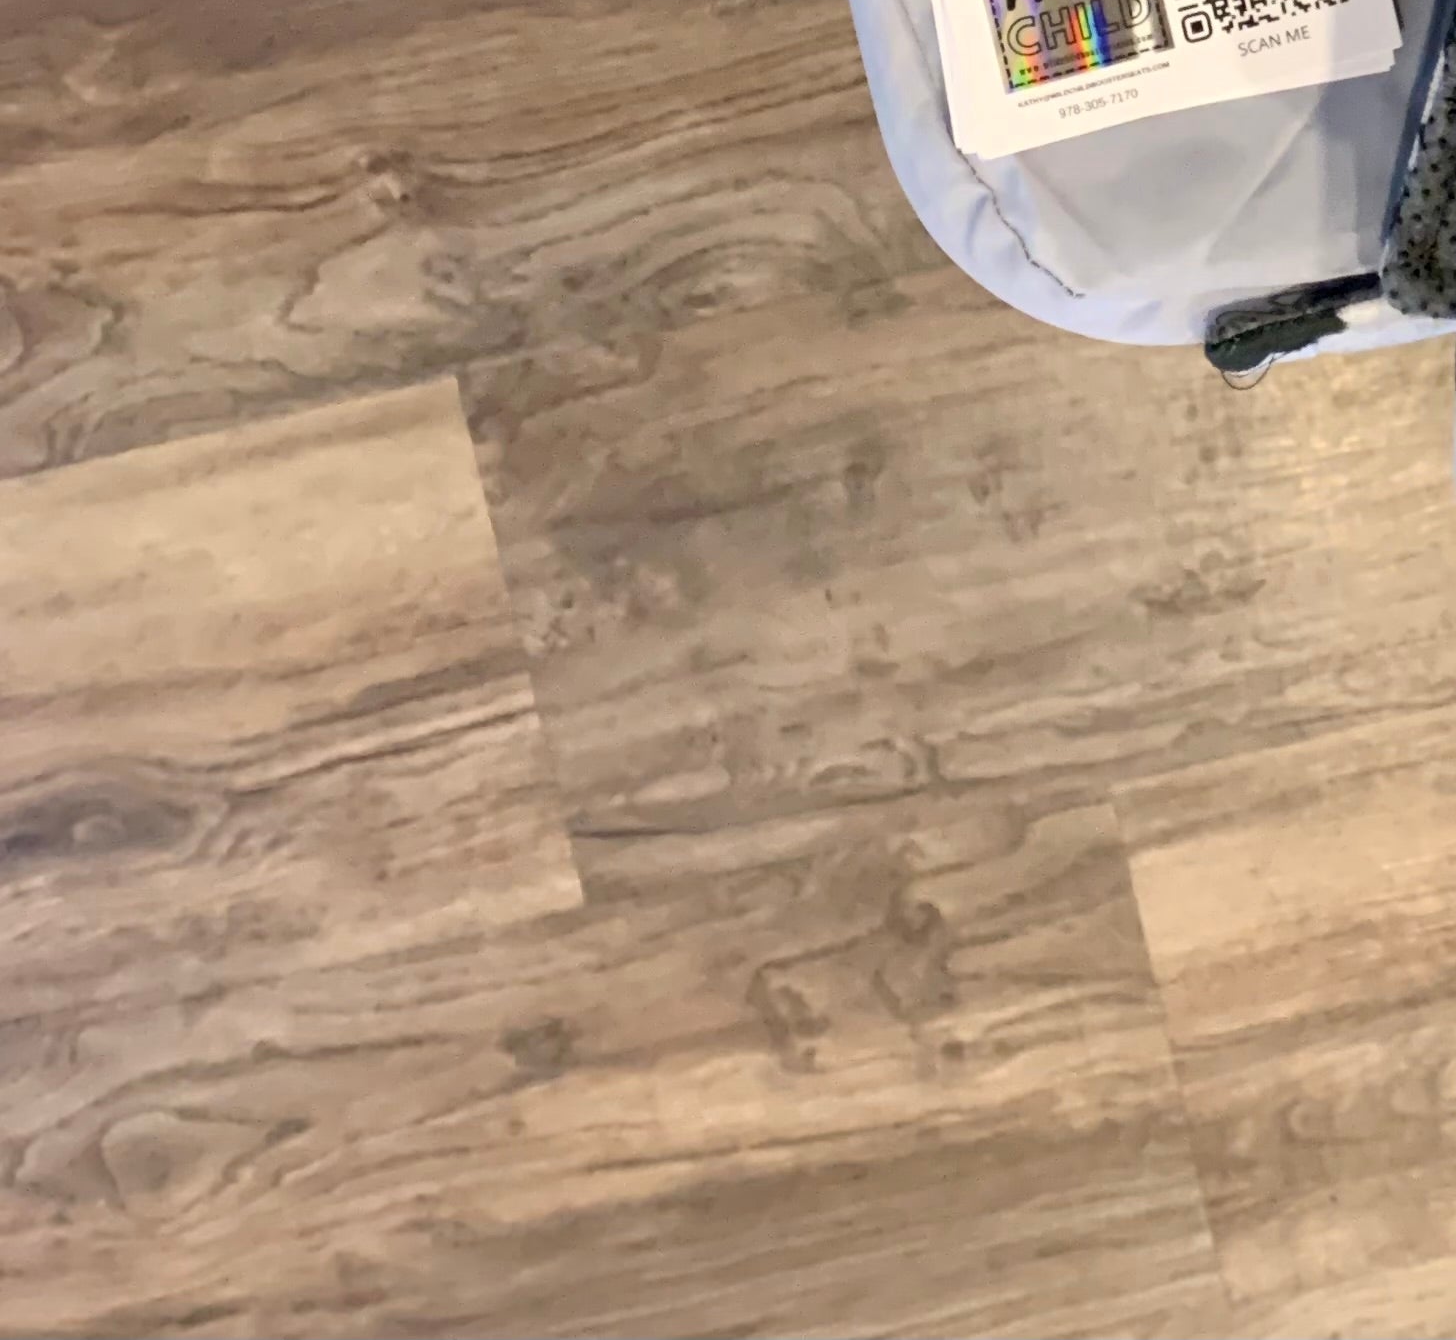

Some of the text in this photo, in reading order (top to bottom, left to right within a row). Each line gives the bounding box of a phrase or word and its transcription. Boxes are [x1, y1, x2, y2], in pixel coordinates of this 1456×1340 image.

[1237, 25, 1311, 57] SCAN ME
[1058, 88, 1139, 119] 978-305-7170
